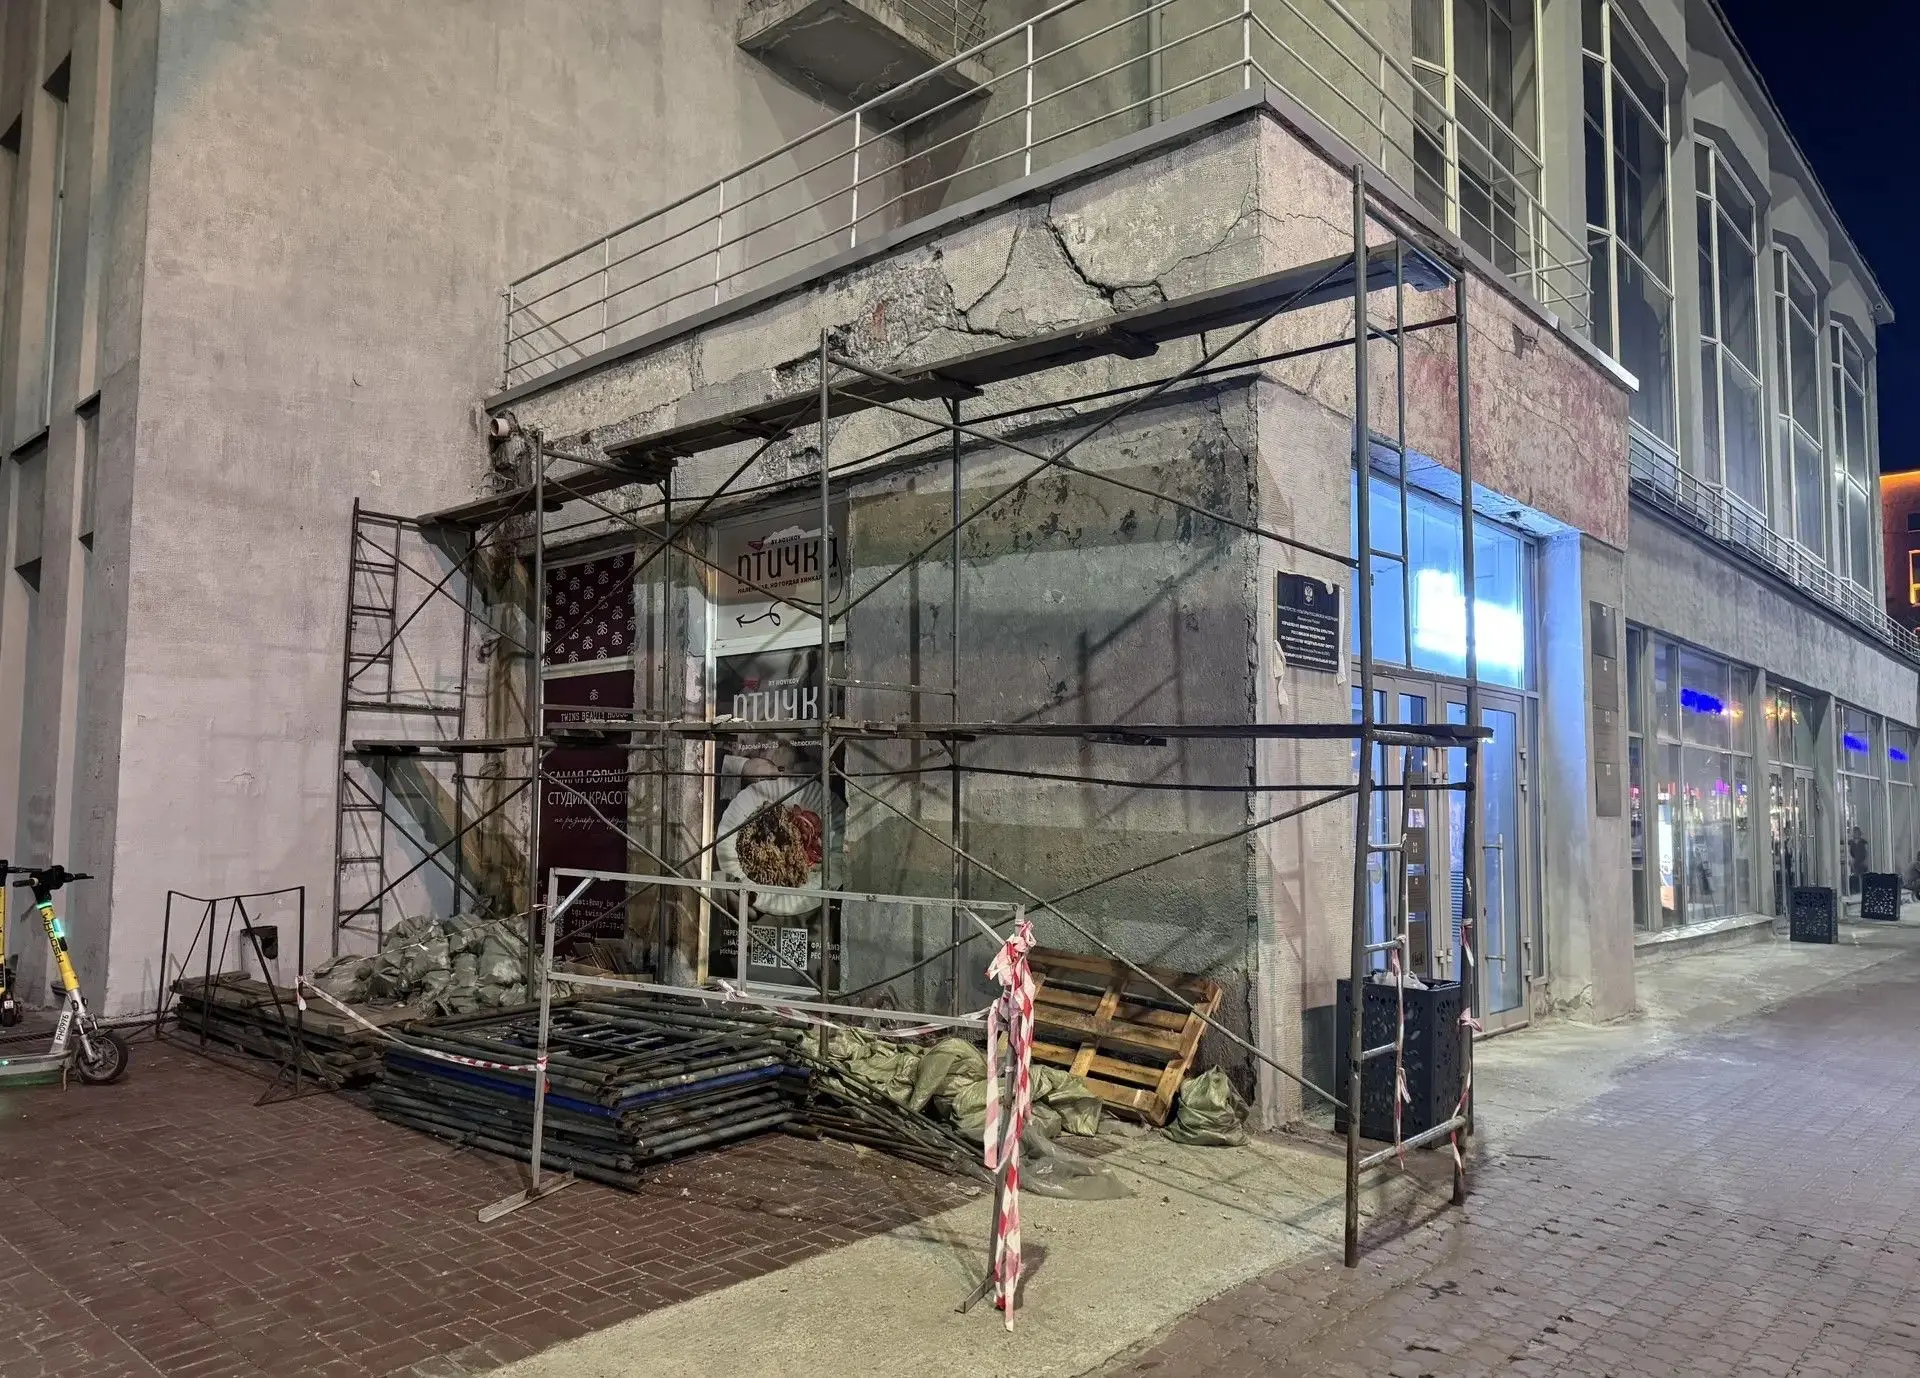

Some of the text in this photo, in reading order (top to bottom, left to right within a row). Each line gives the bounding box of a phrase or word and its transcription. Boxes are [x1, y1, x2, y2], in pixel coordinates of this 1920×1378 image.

[561, 713, 580, 722] TWINS
[547, 790, 588, 808] СТУДИЯ
[42, 912, 64, 964] WHOOSH
